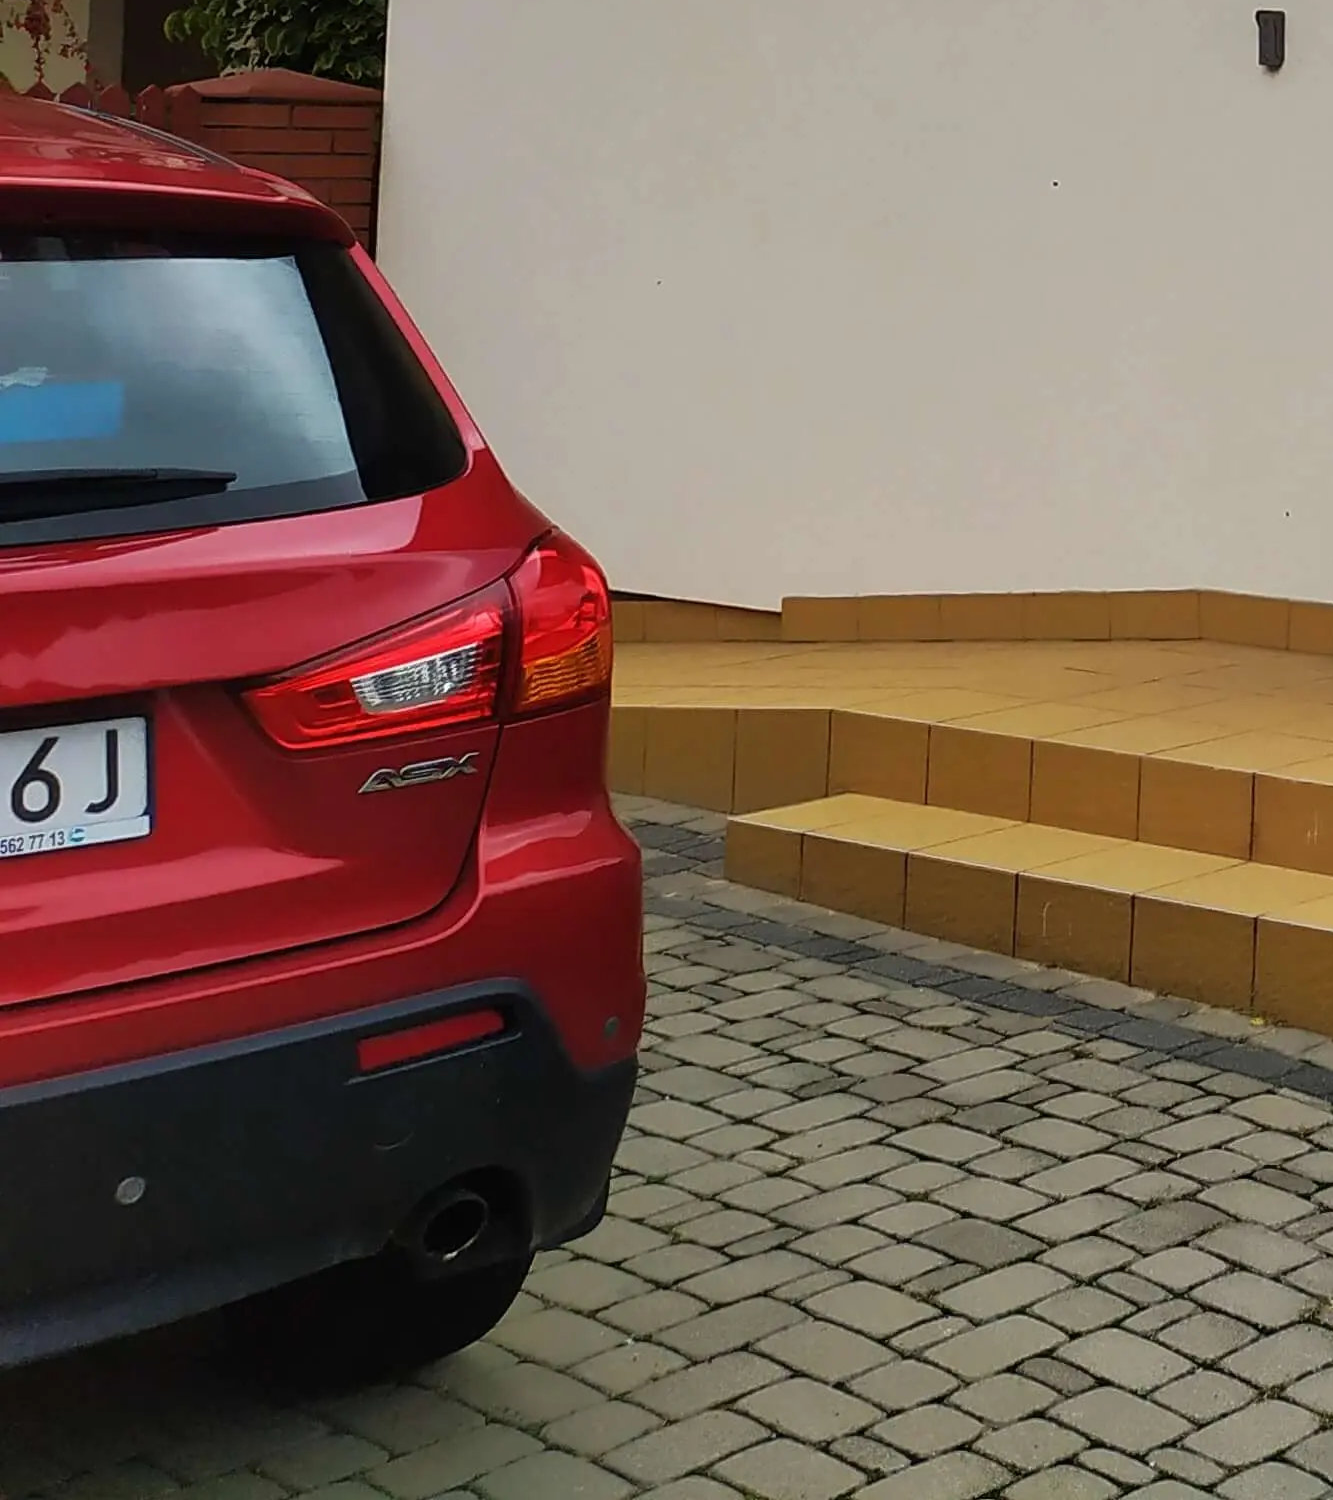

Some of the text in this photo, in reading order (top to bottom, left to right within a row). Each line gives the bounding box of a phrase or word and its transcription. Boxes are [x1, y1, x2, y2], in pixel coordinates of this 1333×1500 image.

[358, 751, 480, 793] ASX
[29, 834, 44, 850] 77
[49, 831, 65, 846] 13
